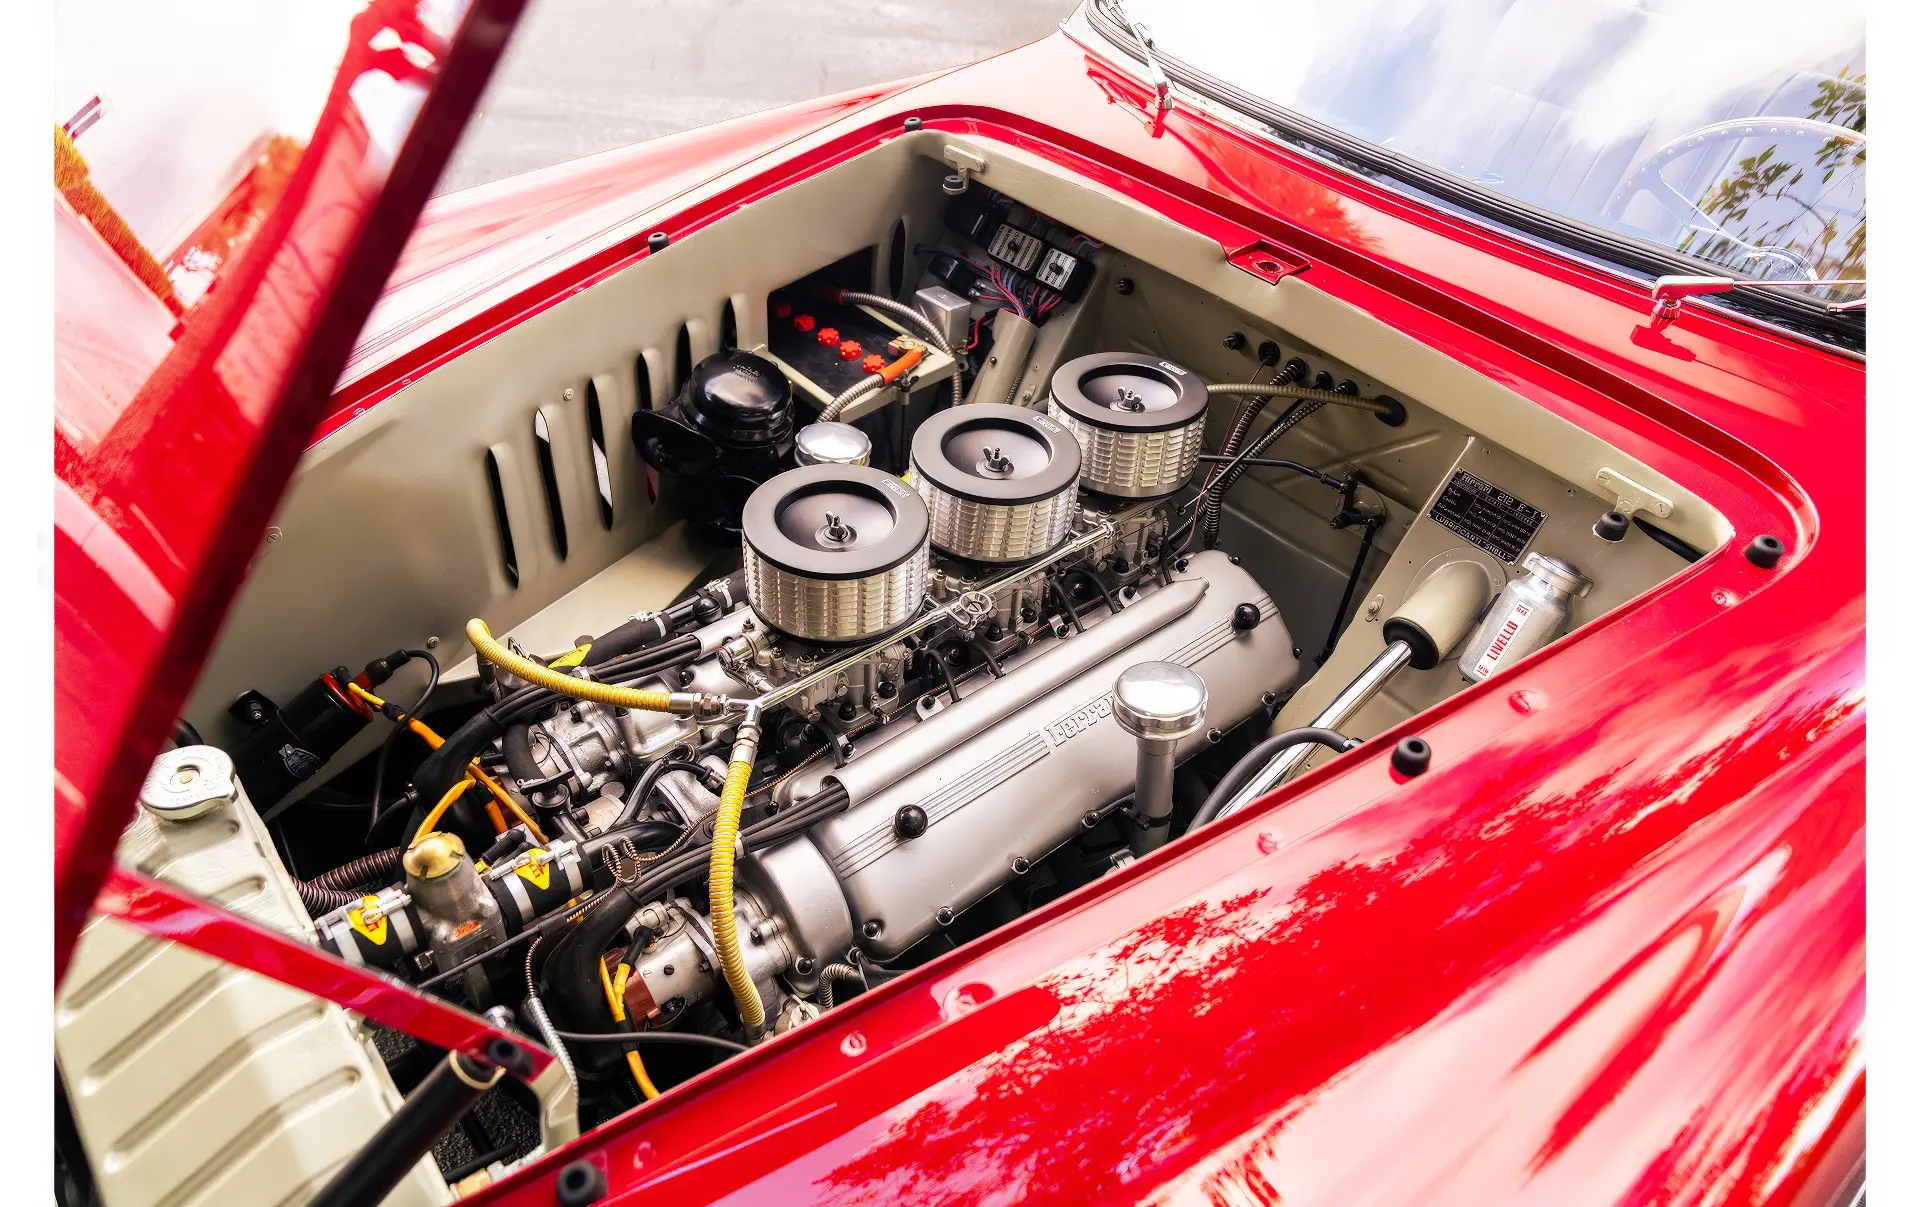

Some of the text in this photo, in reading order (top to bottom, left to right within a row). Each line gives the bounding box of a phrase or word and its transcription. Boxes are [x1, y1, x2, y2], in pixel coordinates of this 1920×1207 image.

[1497, 492, 1514, 506] 212
[1486, 620, 1519, 661] LIVELLO
[1043, 688, 1114, 747] Ferra
